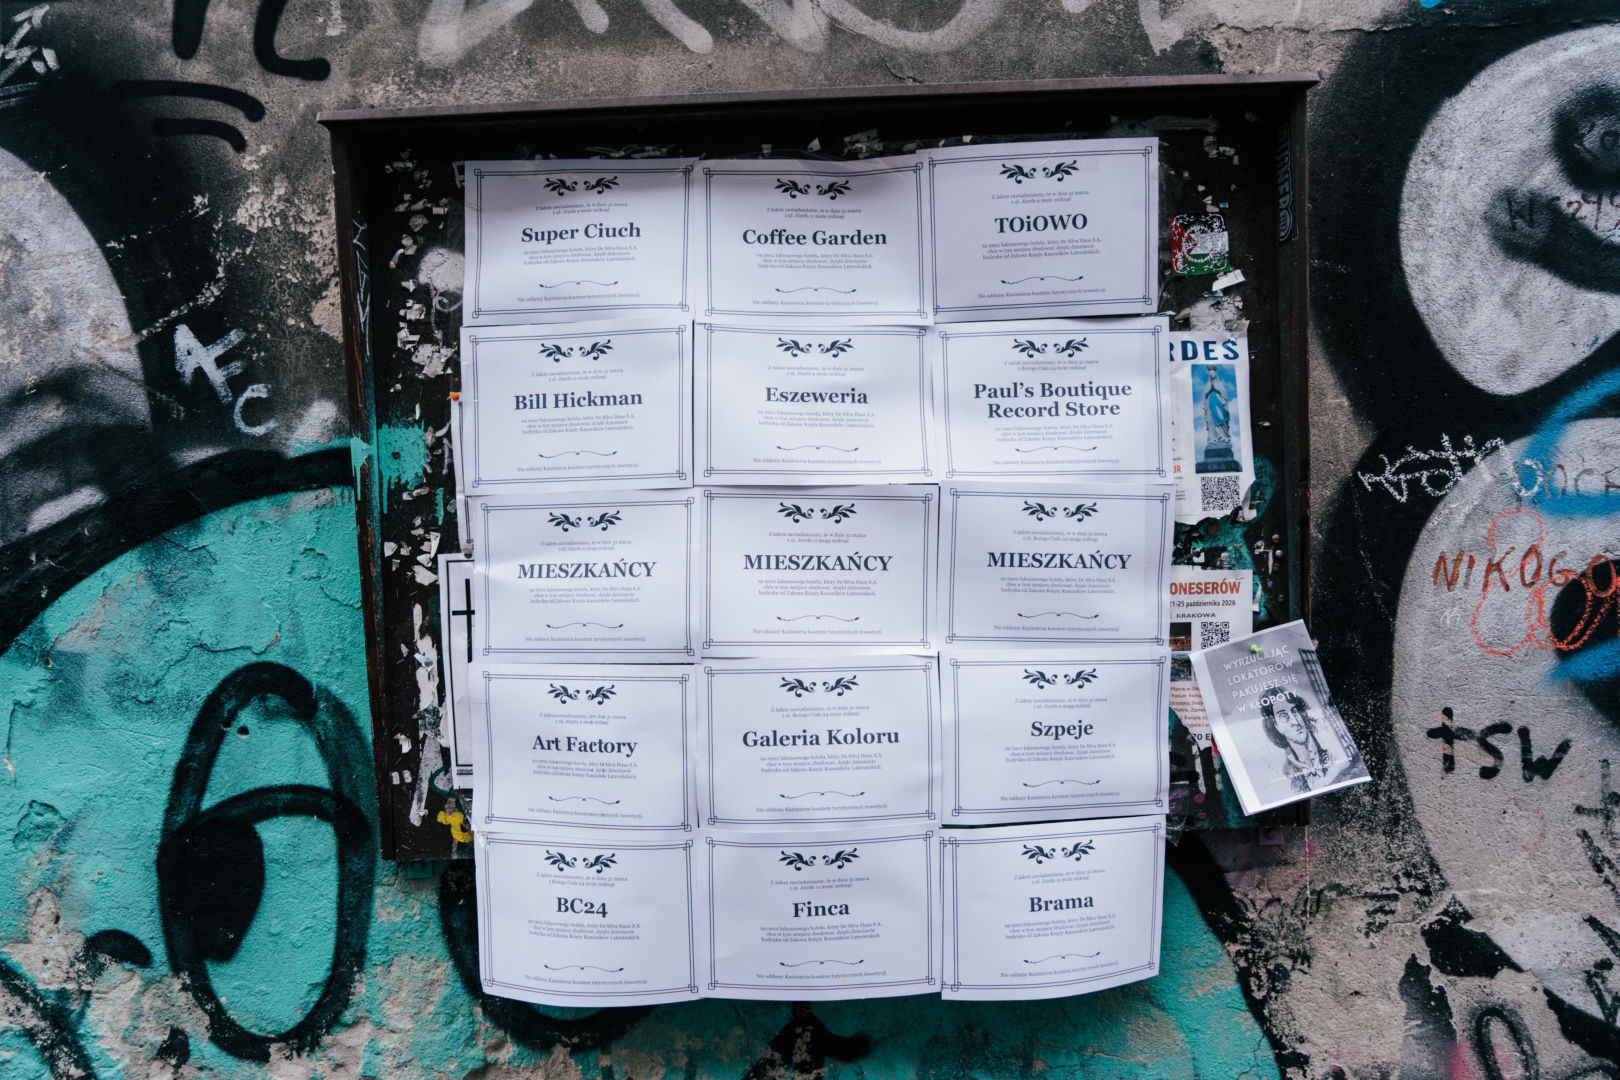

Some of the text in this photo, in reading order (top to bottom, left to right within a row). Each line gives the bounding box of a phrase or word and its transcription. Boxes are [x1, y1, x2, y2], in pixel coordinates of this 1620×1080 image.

[521, 221, 641, 245] Super Ciuch
[994, 213, 1088, 234] TOiOWO
[742, 228, 887, 246] Coffee Garden
[513, 390, 642, 410] Bill Hickman
[766, 387, 868, 404] Eszeweria
[1039, 380, 1132, 401] Boutique
[987, 400, 1121, 419] Record Store
[517, 558, 657, 579] MIESZKAŃCY
[743, 551, 893, 572] MIESZKAŃCY
[987, 549, 1132, 570] MIESZKAŃCY
[1431, 544, 1616, 598] NIKOGO
[1170, 578, 1241, 596] ONESERÓW
[1186, 600, 1220, 608] października
[1222, 644, 1290, 671] WYRZUCAJĄC
[1227, 659, 1294, 686] LOKATORÓW
[1232, 673, 1298, 700] PAKUJESZ SIĘ
[1250, 688, 1298, 709] KŁOPOTY
[742, 727, 900, 748] Galeria Koloru
[1030, 719, 1094, 741] Szpeje
[532, 735, 638, 758] Art Factory
[557, 897, 608, 919] BC24
[792, 900, 850, 918] Finca
[1028, 896, 1094, 913] Brama
